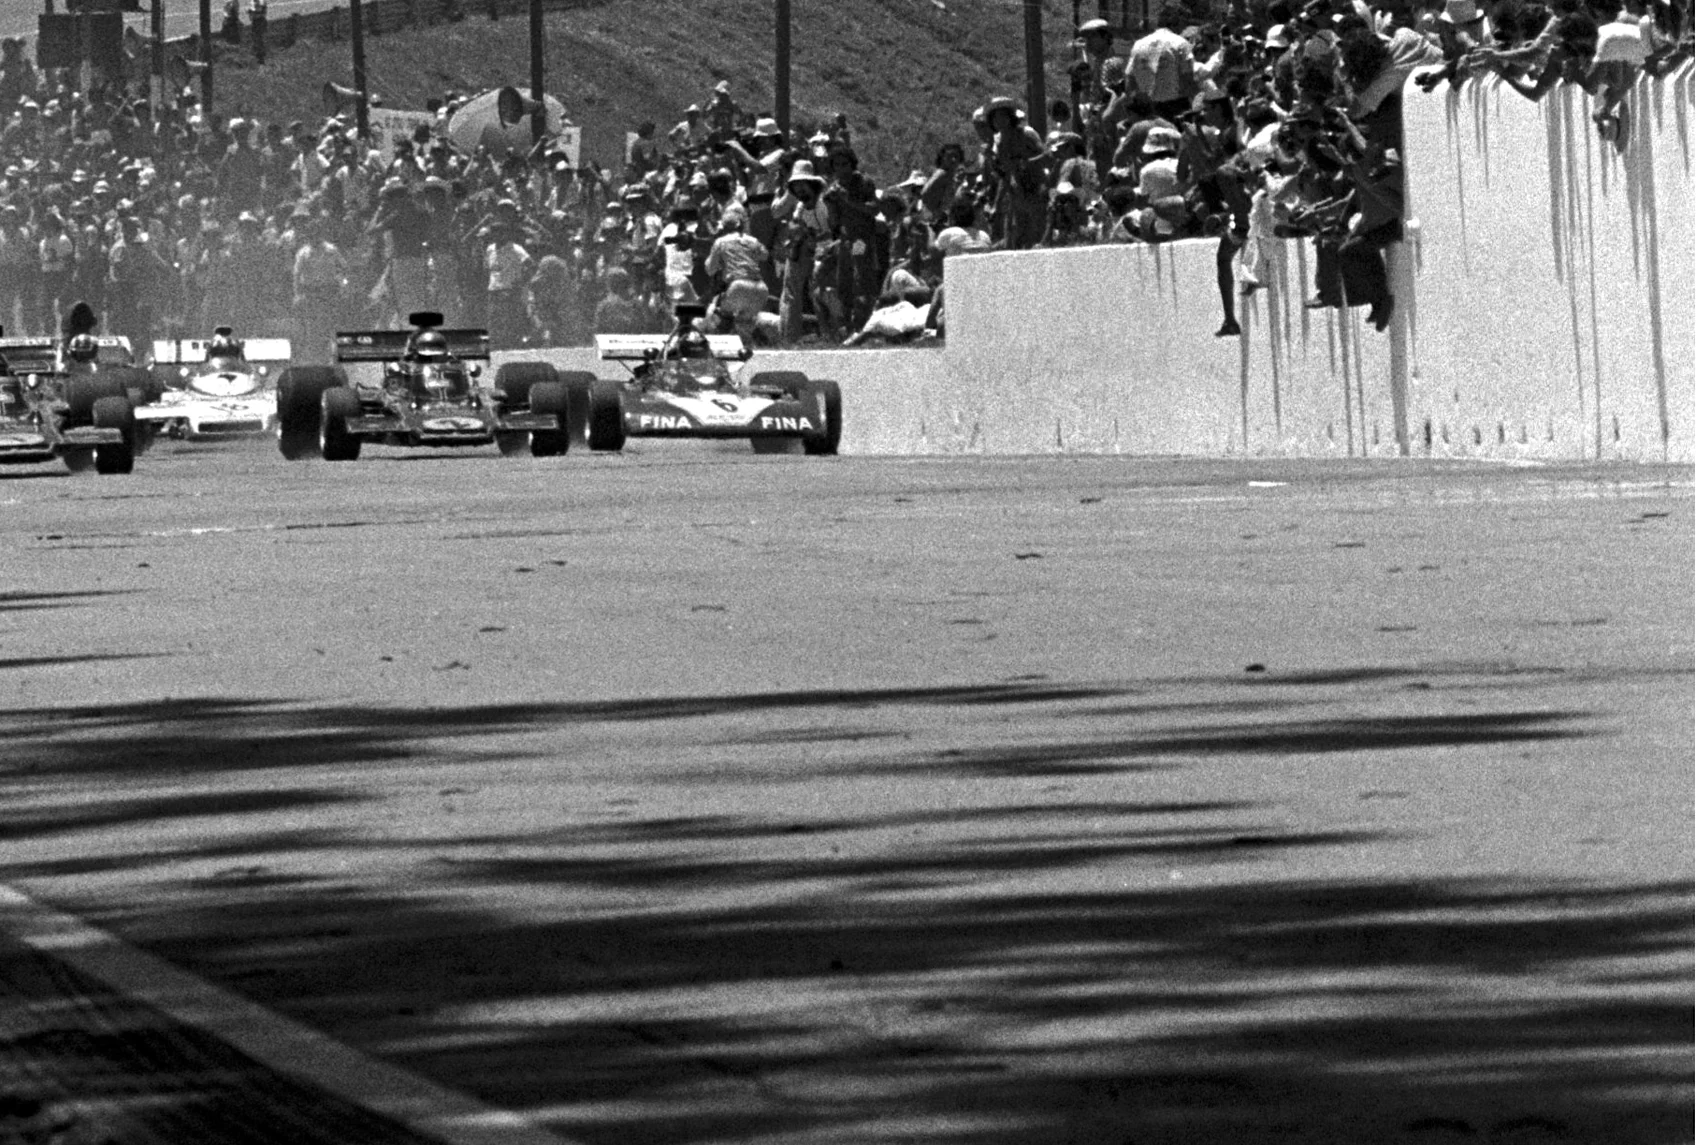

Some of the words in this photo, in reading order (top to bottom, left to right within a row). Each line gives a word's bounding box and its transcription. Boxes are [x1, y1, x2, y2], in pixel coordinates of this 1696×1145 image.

[711, 398, 738, 413] 6
[639, 414, 692, 429] FINA
[761, 415, 813, 431] FINA
